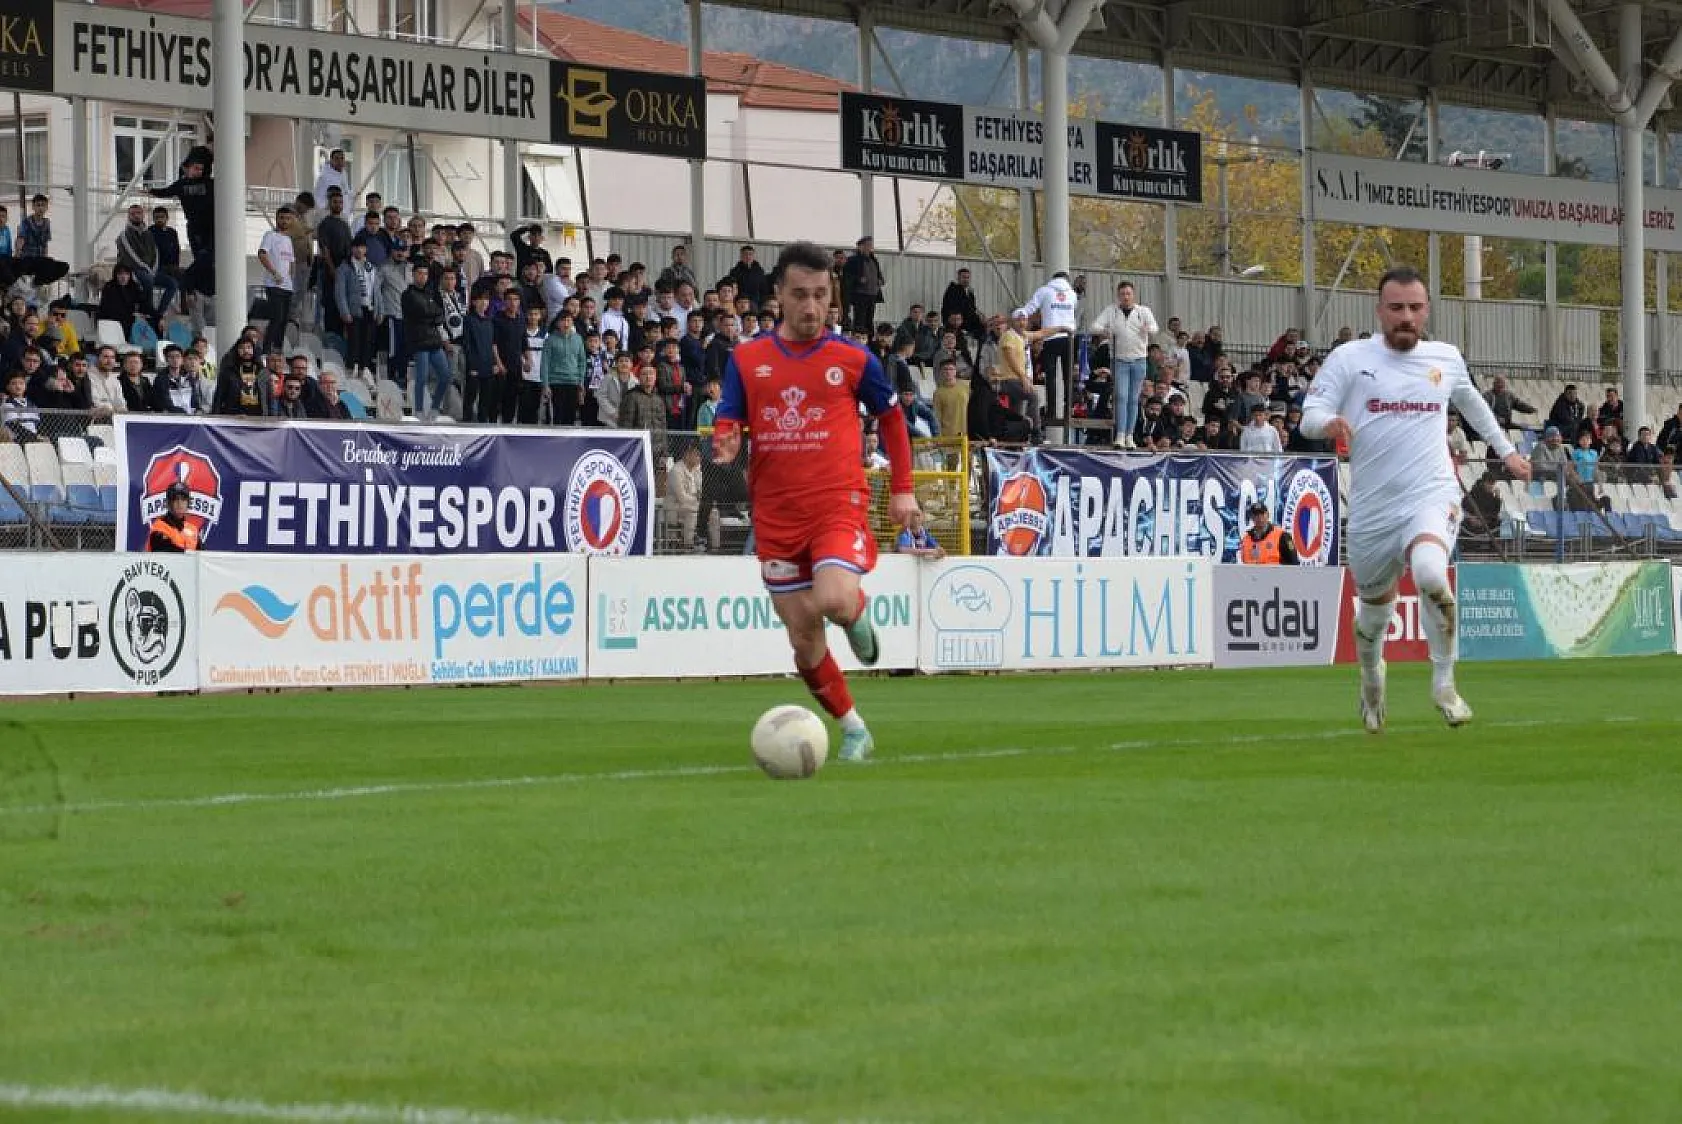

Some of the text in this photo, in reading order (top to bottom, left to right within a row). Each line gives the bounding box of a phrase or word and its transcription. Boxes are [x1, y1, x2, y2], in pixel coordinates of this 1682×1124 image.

[73, 17, 536, 119] FETHİYESR'A BAŞARILAR DİLER
[626, 88, 698, 129] ORKA
[1399, 183, 1430, 208] BELLİ
[236, 467, 556, 549] FETHİYESPOR
[1053, 476, 1225, 561] APACHES
[124, 561, 171, 582] BAVYERA
[308, 562, 575, 660] aktif perde
[642, 597, 709, 631] ASSA
[1021, 562, 1197, 658] HİLMİ
[1227, 587, 1319, 651] erday
[941, 634, 996, 663] HİLMİ
[136, 669, 160, 686] PUB
